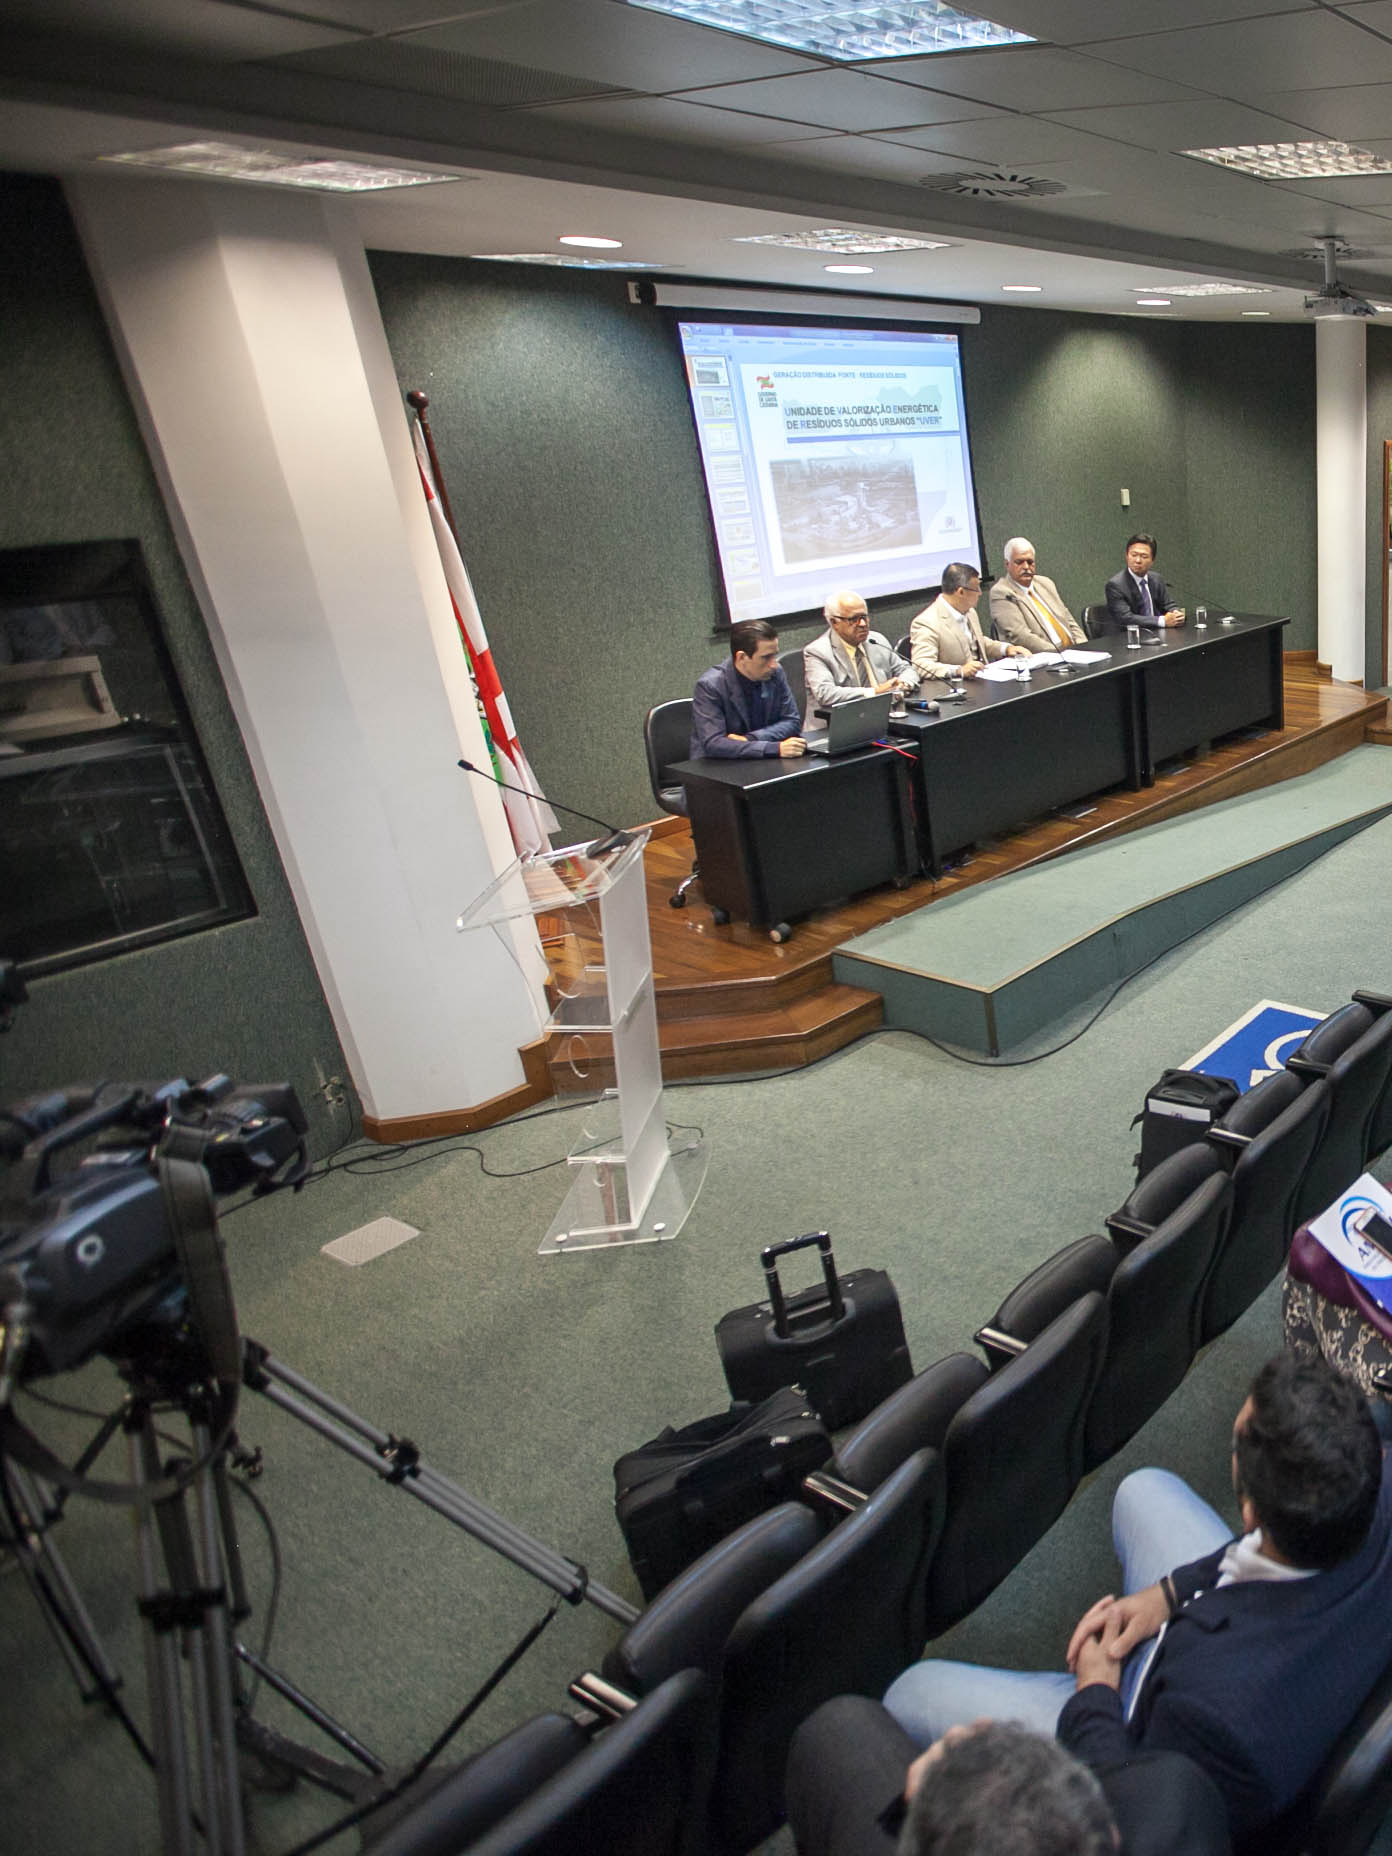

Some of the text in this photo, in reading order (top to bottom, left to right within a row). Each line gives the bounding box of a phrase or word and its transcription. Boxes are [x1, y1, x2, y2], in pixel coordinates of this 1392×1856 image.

[784, 403, 938, 417] UNIDADE DE VALORIZAÇÃO ENERGÉTICA
[786, 420, 799, 430] DE
[800, 418, 843, 429] RESÍDUOS
[844, 417, 878, 428] SÓLIDOS
[879, 416, 916, 427] URBANOS
